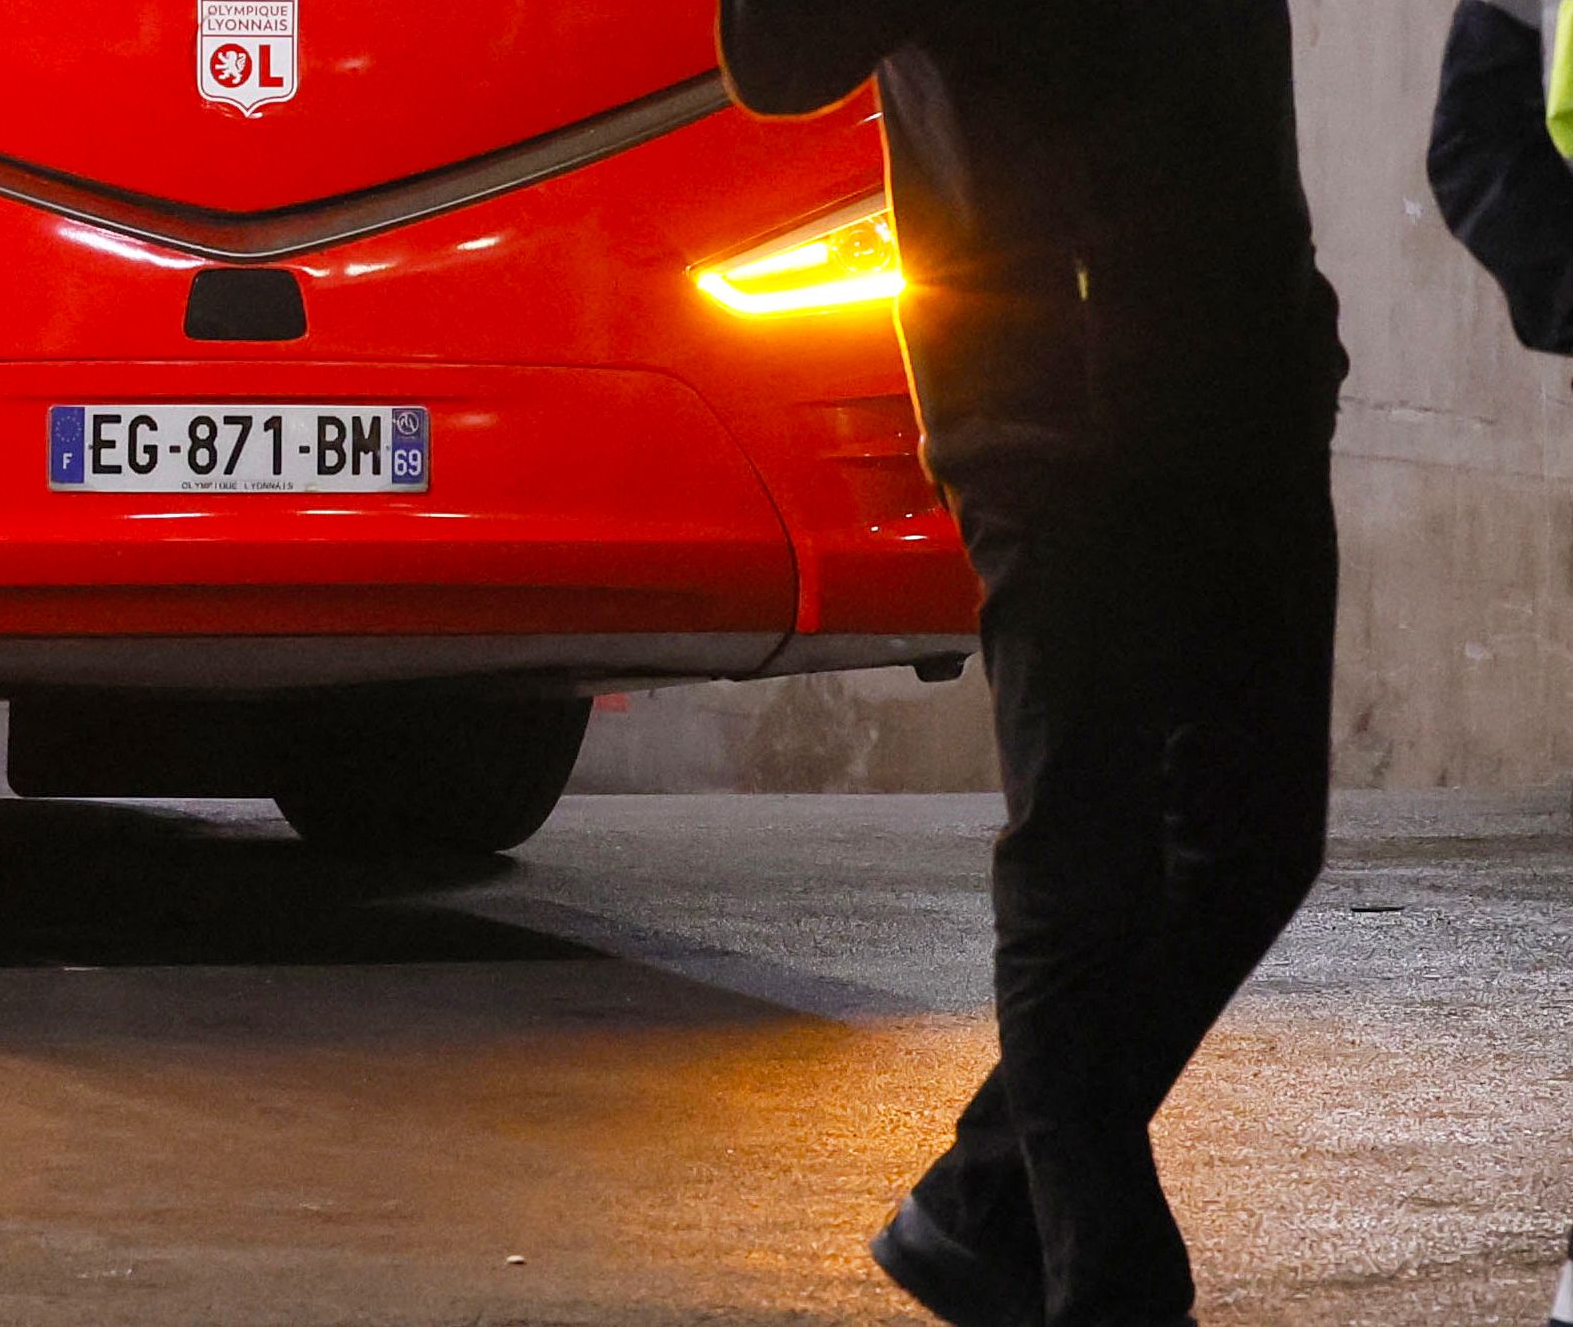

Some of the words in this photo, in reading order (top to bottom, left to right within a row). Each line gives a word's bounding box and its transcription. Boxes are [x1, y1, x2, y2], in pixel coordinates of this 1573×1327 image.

[207, 5, 288, 19] OLYMPIQUE
[207, 18, 288, 31] LYONNAIS
[210, 43, 284, 88] OL
[62, 453, 73, 469] F
[92, 414, 382, 475] EG-871-BM
[394, 449, 422, 477] 69
